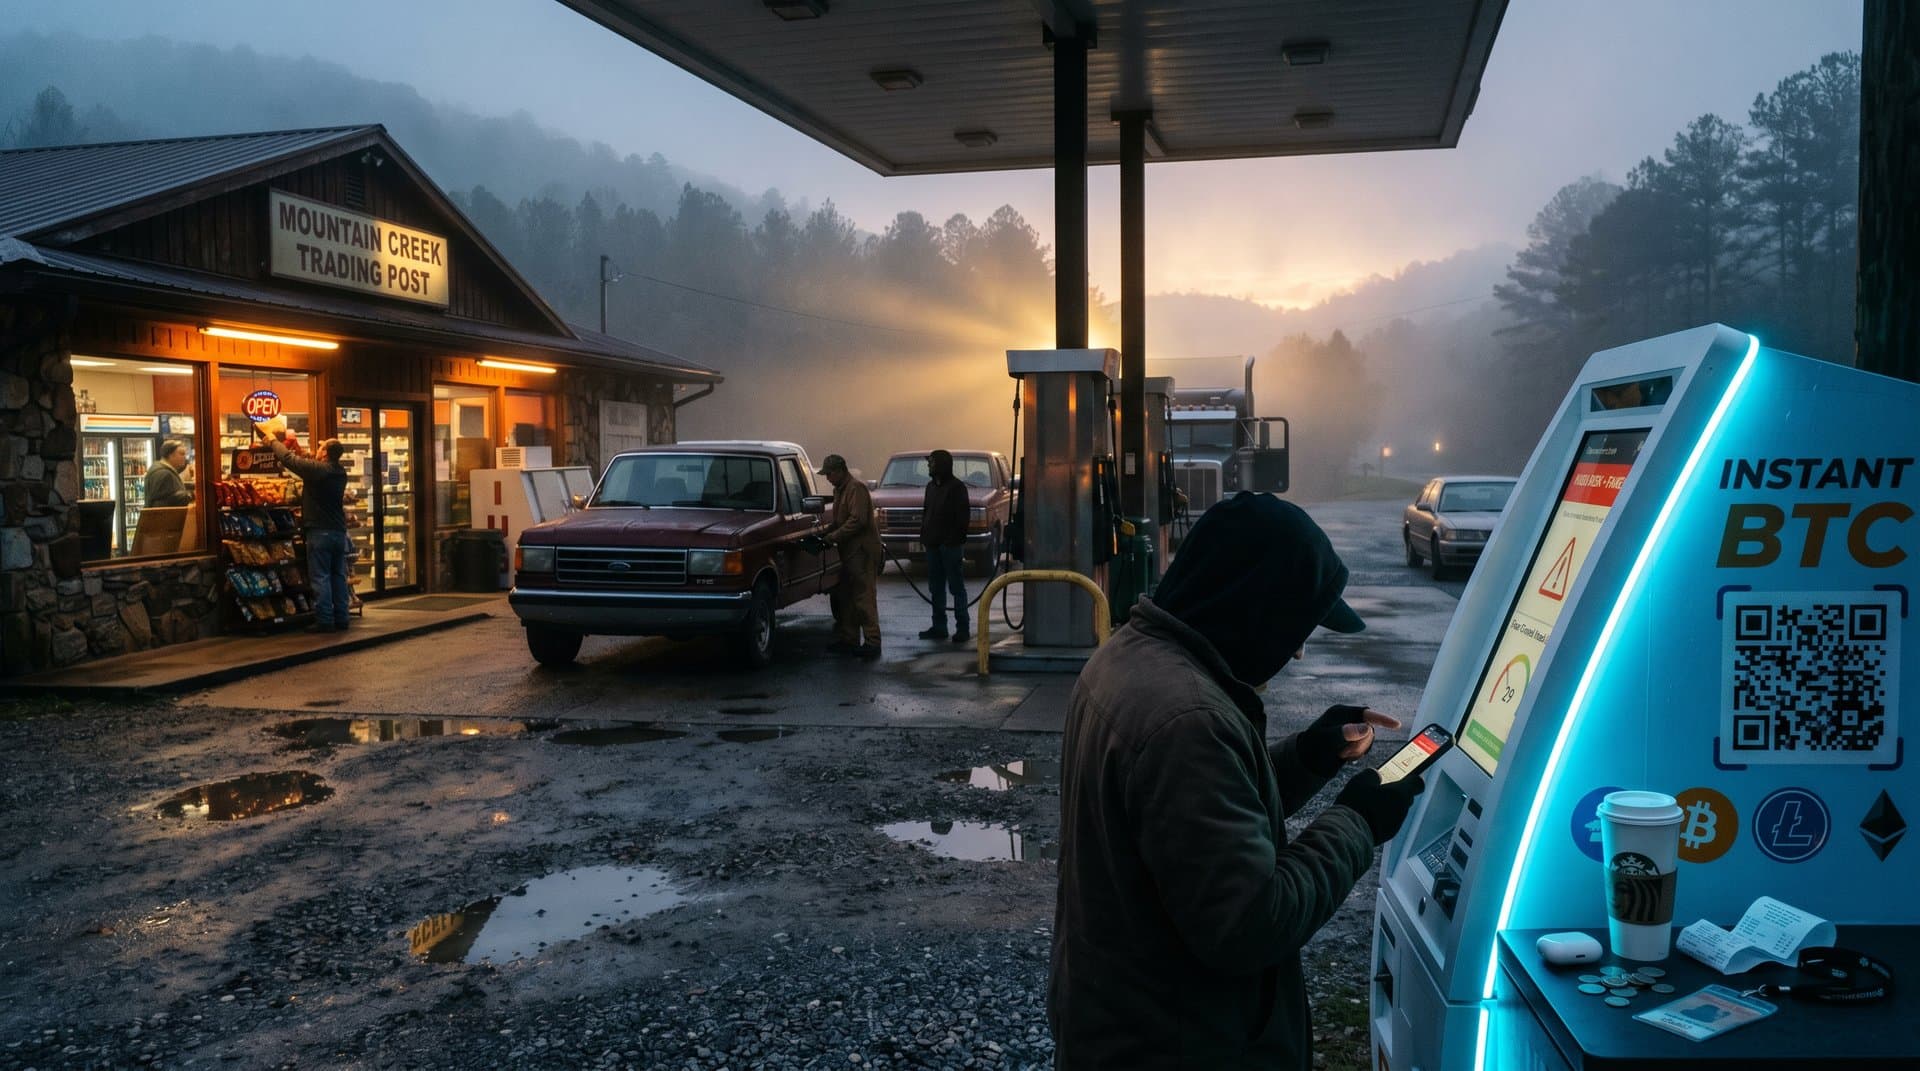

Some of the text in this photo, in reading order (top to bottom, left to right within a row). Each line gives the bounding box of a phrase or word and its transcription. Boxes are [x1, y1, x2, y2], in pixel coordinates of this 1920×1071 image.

[279, 201, 442, 267] MOUNTAIN CREEK
[296, 243, 430, 296] TRADING POST
[247, 398, 279, 415] OPEN
[1719, 457, 1915, 490] INSTANT
[1716, 501, 1916, 569] BTC
[1502, 686, 1515, 703] 29
